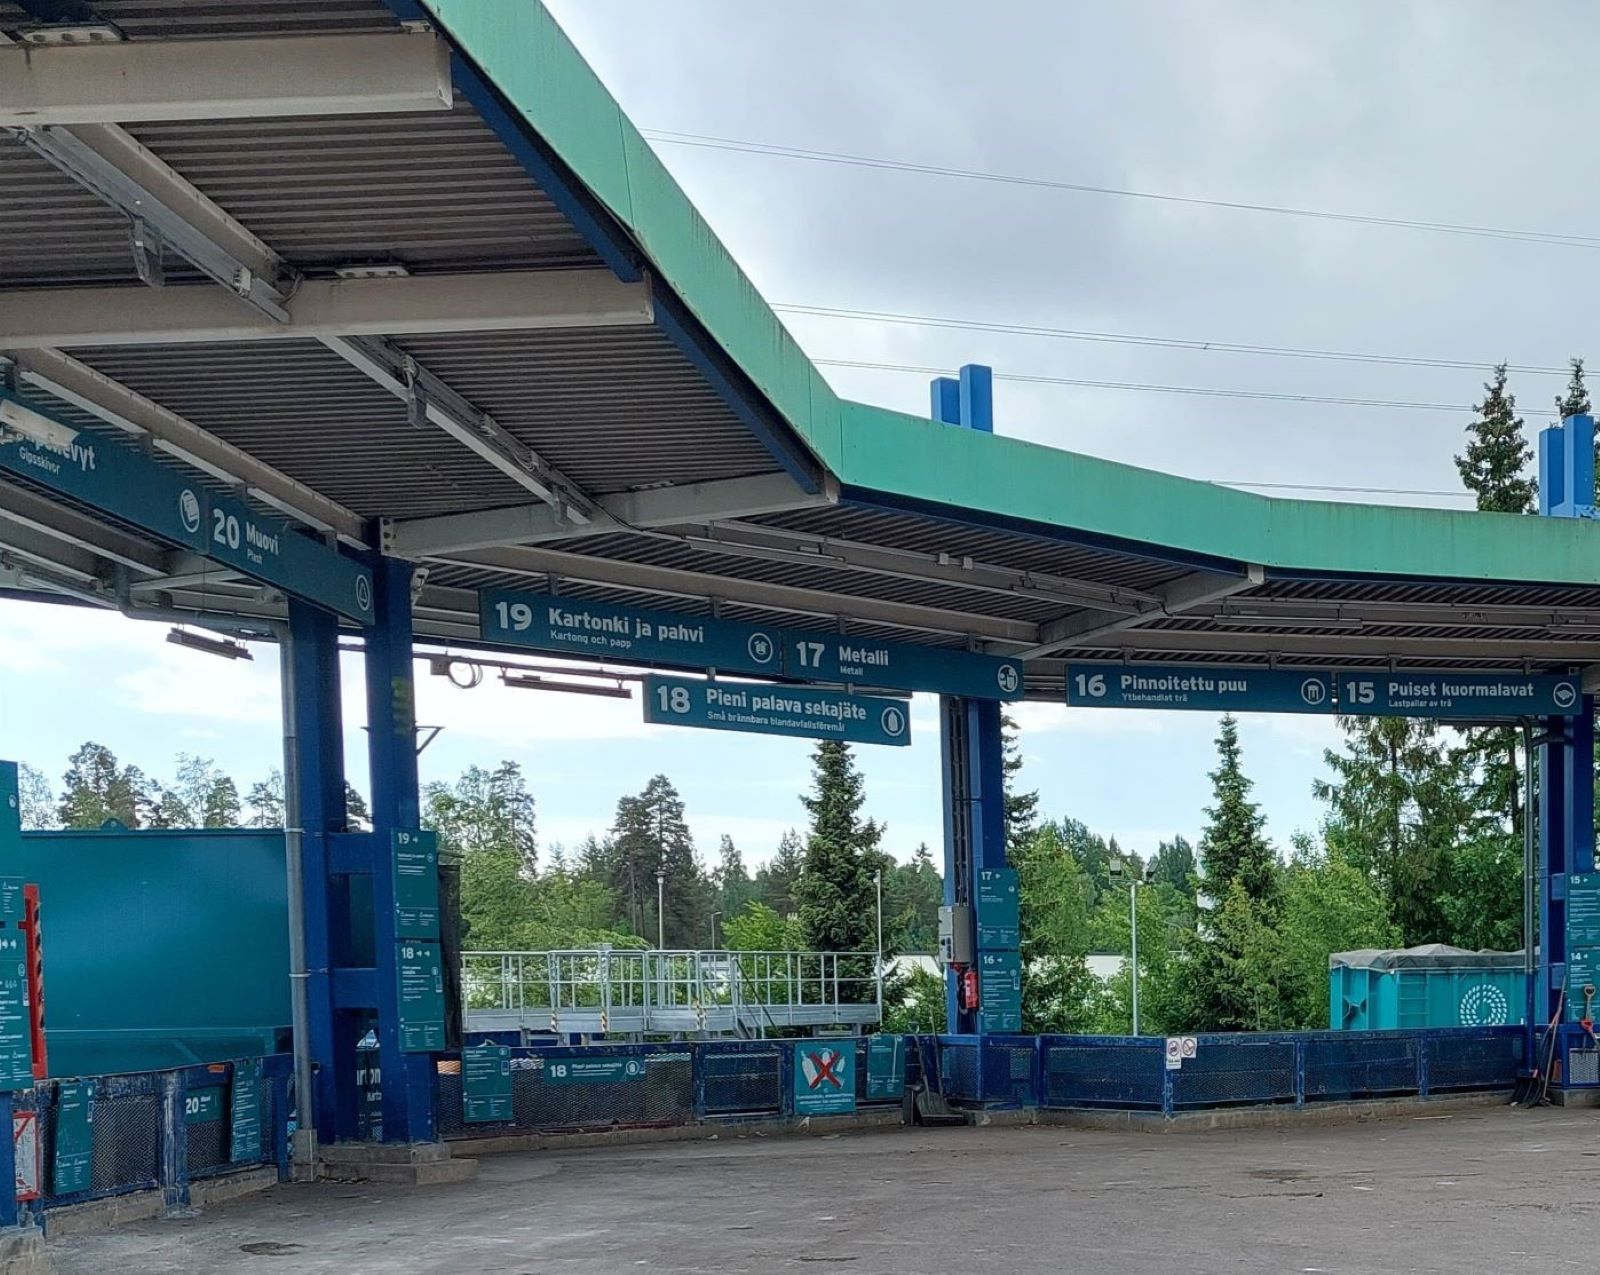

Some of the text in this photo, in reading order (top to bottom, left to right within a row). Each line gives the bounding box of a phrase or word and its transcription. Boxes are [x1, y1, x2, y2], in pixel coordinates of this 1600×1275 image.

[213, 508, 279, 555] 20 Muovi
[495, 601, 704, 643] 19 Kartonki ja pahvi
[550, 629, 632, 649] Kartong och papp
[796, 641, 889, 667] 17 Metalli
[840, 666, 864, 676] Metall
[1075, 674, 1247, 697] 16 Pinnoitettu puu
[1346, 681, 1534, 704] 15 Puiset kuormalavat
[657, 685, 867, 721] 18 Pieni palava sekajäte
[707, 710, 726, 721] Små
[728, 712, 769, 725] brännbara
[398, 832, 410, 844] 19
[981, 871, 992, 881] 17
[1570, 876, 1581, 884] 15
[402, 947, 414, 959] 18
[983, 955, 995, 965] 16
[1570, 952, 1581, 961] 14
[550, 1064, 567, 1078] 18
[185, 1097, 199, 1115] 20
